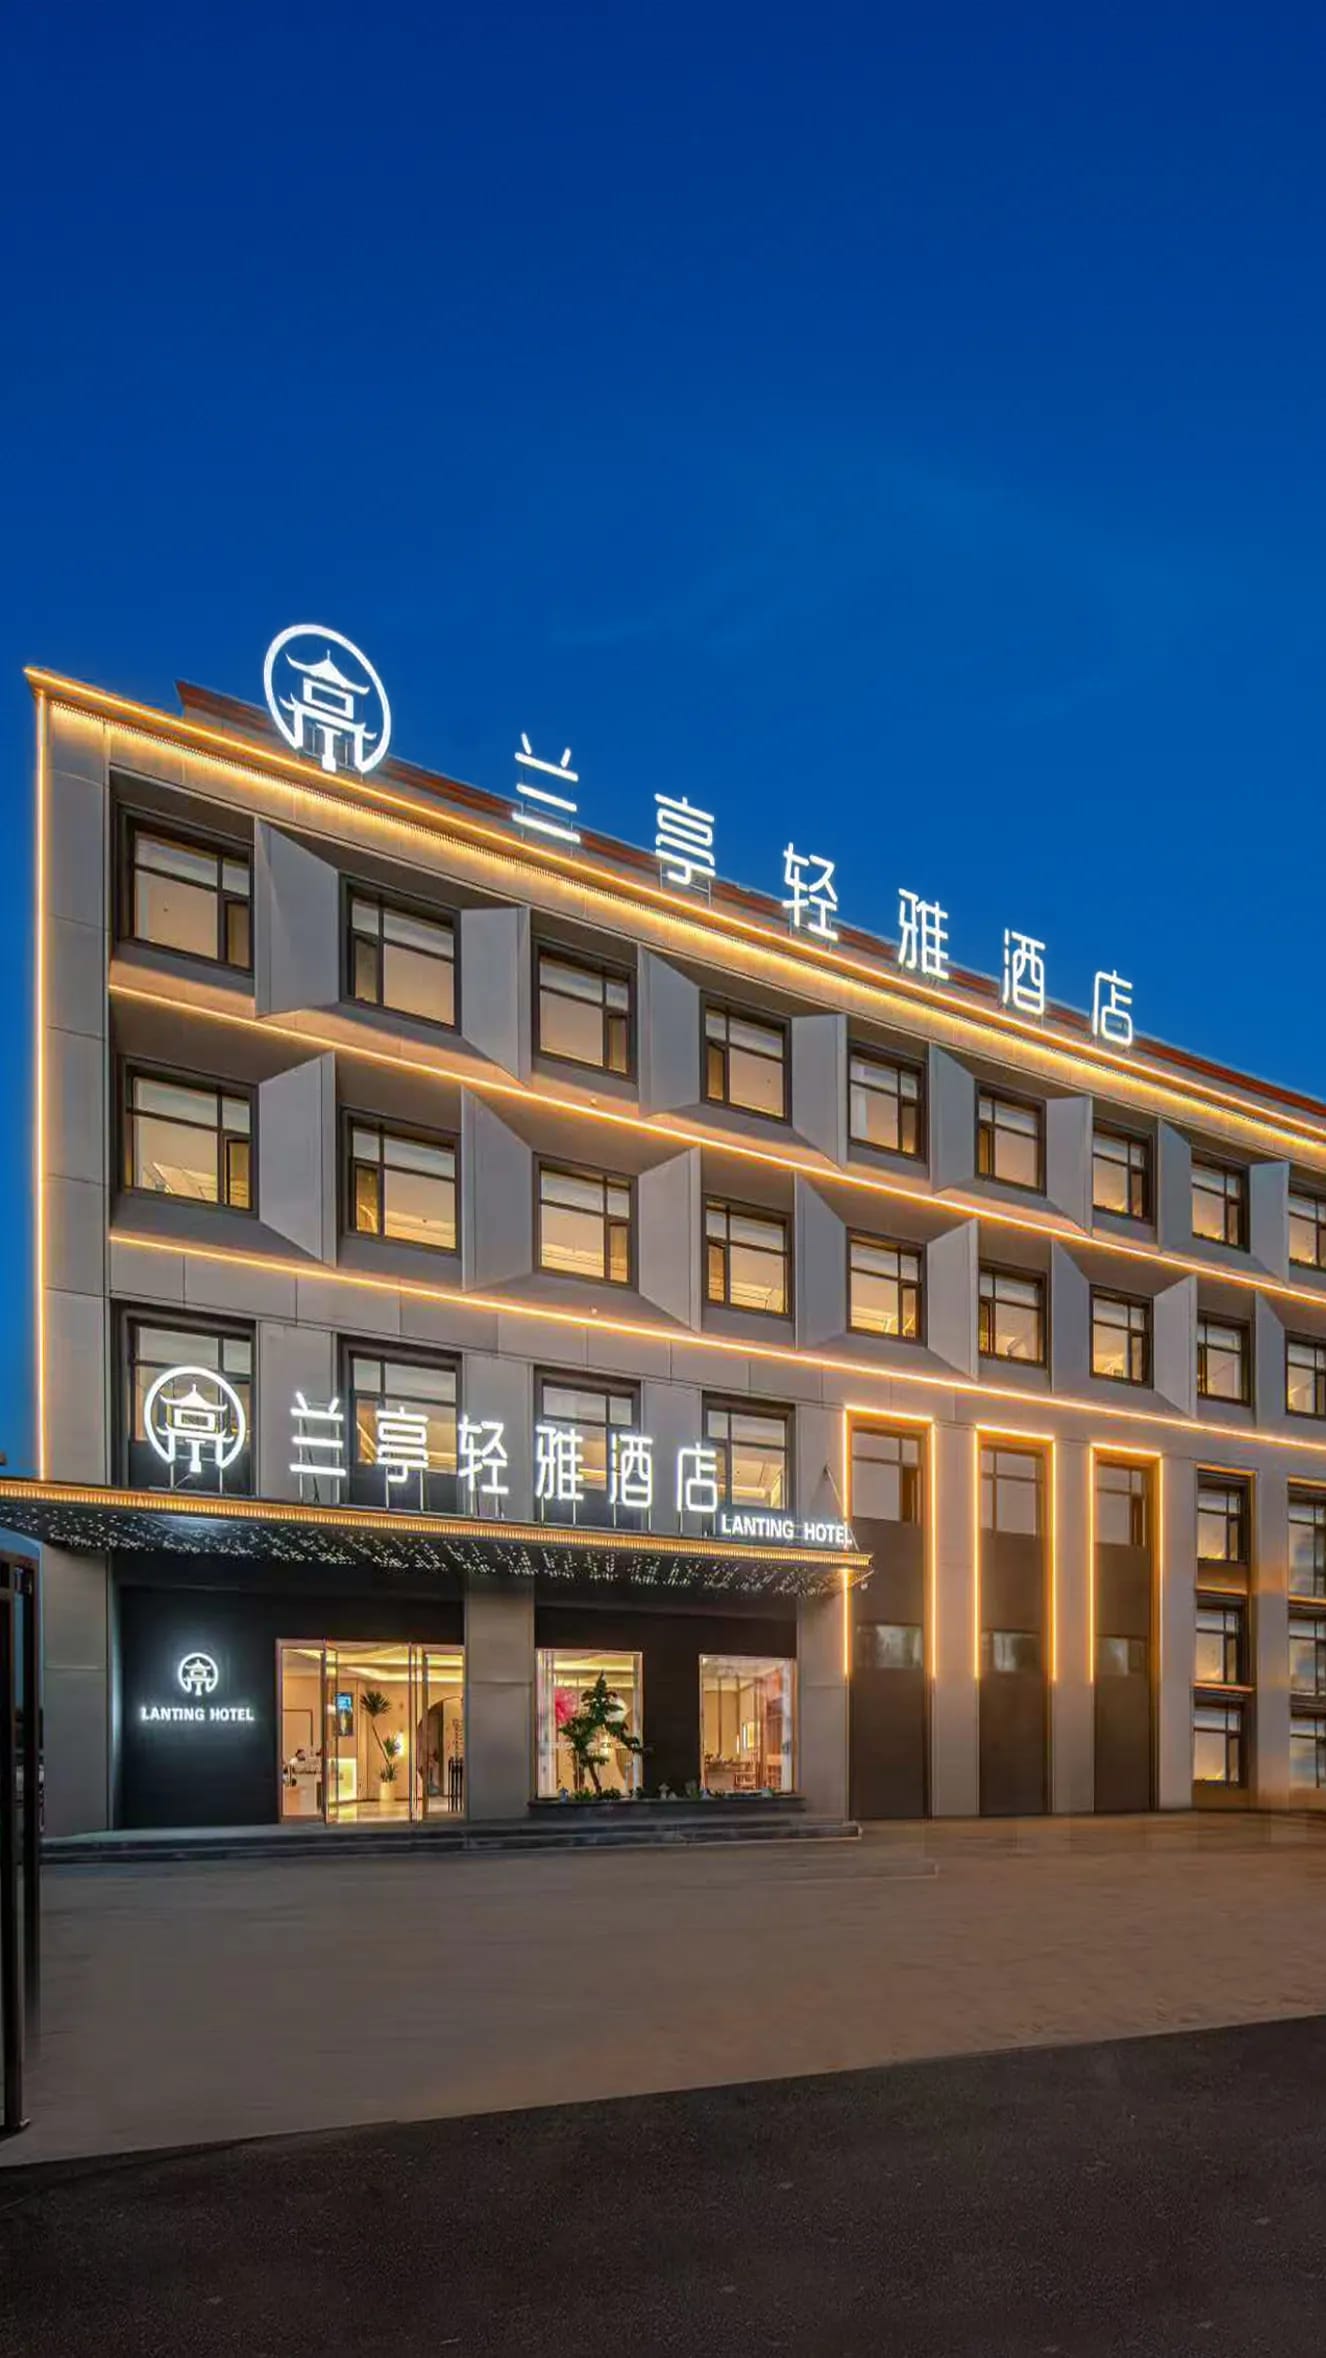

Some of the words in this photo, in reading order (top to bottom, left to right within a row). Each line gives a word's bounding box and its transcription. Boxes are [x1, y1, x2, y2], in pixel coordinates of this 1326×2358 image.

[511, 732, 1135, 1048] 兰亭轻雅酒店
[289, 1391, 719, 1513] 兰亭轻雅酒店
[721, 1513, 794, 1540] LANTING
[803, 1521, 853, 1545] HOTEL
[141, 1706, 205, 1722] LANTING
[210, 1707, 255, 1722] HOTEL
